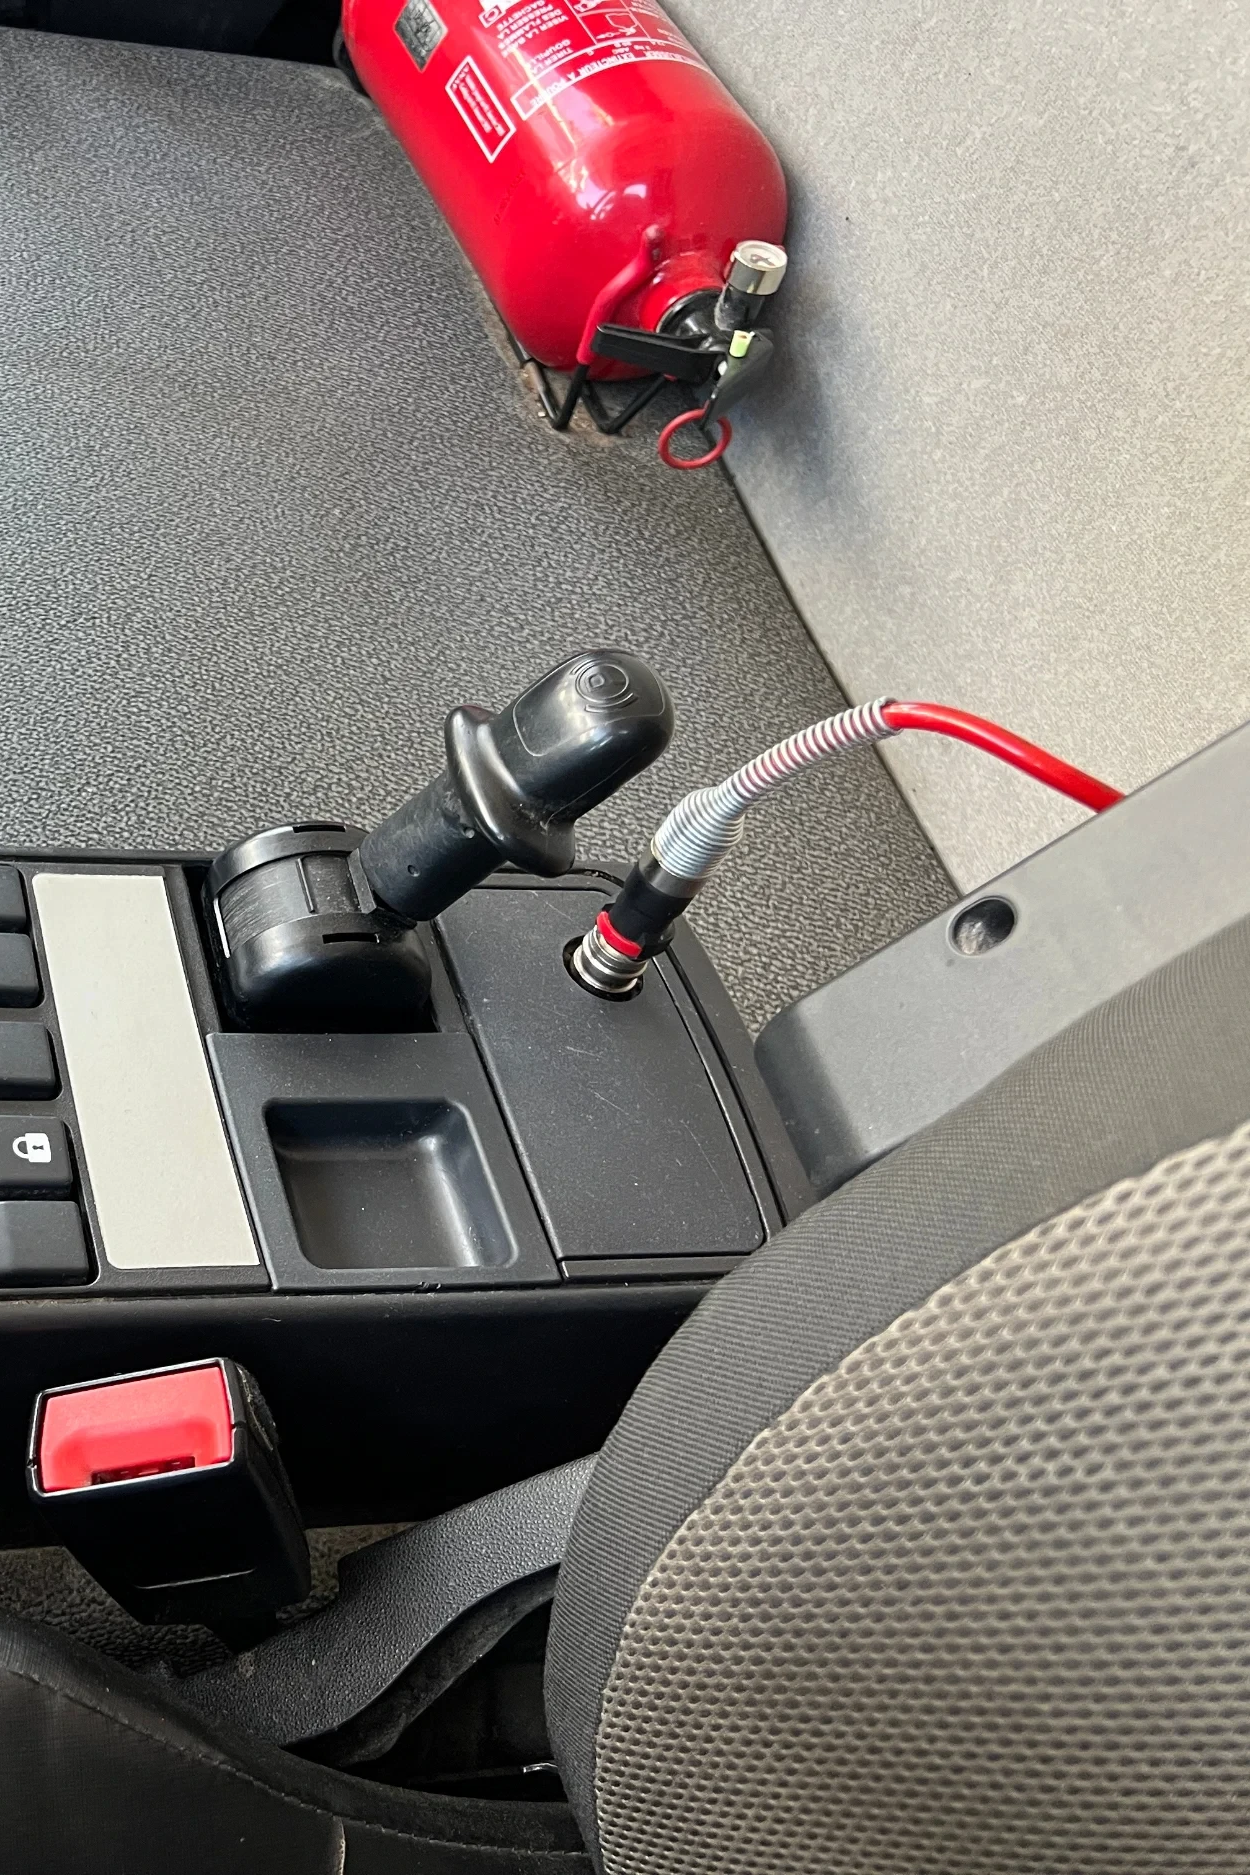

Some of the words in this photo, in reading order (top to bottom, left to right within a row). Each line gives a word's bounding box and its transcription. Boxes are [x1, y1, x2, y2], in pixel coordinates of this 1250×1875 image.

[496, 0, 545, 31] GACHETTE
[510, 4, 553, 31] PRESSER
[539, 15, 568, 31] VISER
[497, 28, 510, 39] LA
[498, 18, 541, 50] FLAMMES
[525, 28, 539, 38] LA
[526, 39, 570, 67] GOUPILL
[544, 47, 573, 65] TIRER
[577, 52, 635, 76] EXTINCTEUR
